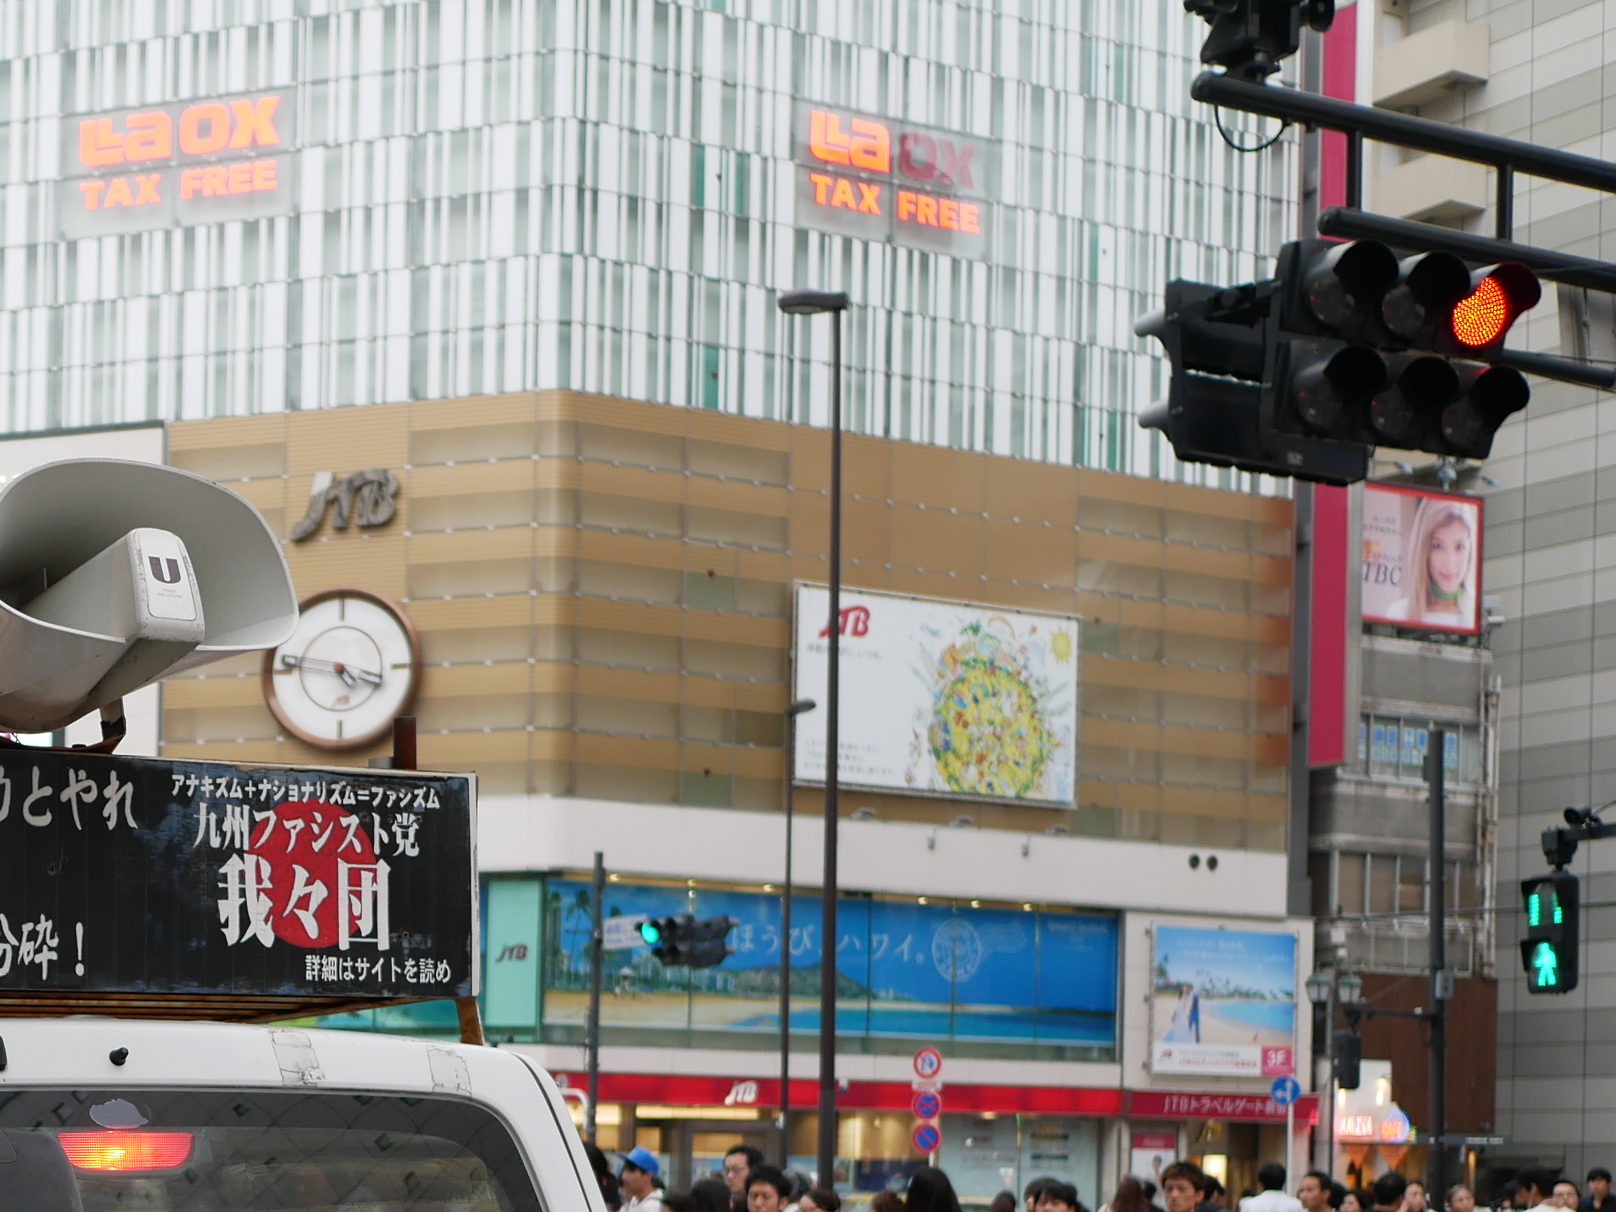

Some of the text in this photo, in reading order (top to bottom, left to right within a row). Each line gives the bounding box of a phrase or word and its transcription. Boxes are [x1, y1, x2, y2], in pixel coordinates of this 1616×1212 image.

[79, 160, 278, 211] TAX FREE
[810, 173, 980, 234] TAX FREE
[290, 468, 400, 545] JTB
[1364, 561, 1403, 586] TBC
[192, 802, 421, 857] 九州ファシスト党
[217, 853, 391, 951] 我々団
[305, 954, 452, 984] 詳細はサイトを読め
[495, 943, 528, 963] JTB
[1267, 1049, 1287, 1067] 3F
[724, 1080, 758, 1106] JTB
